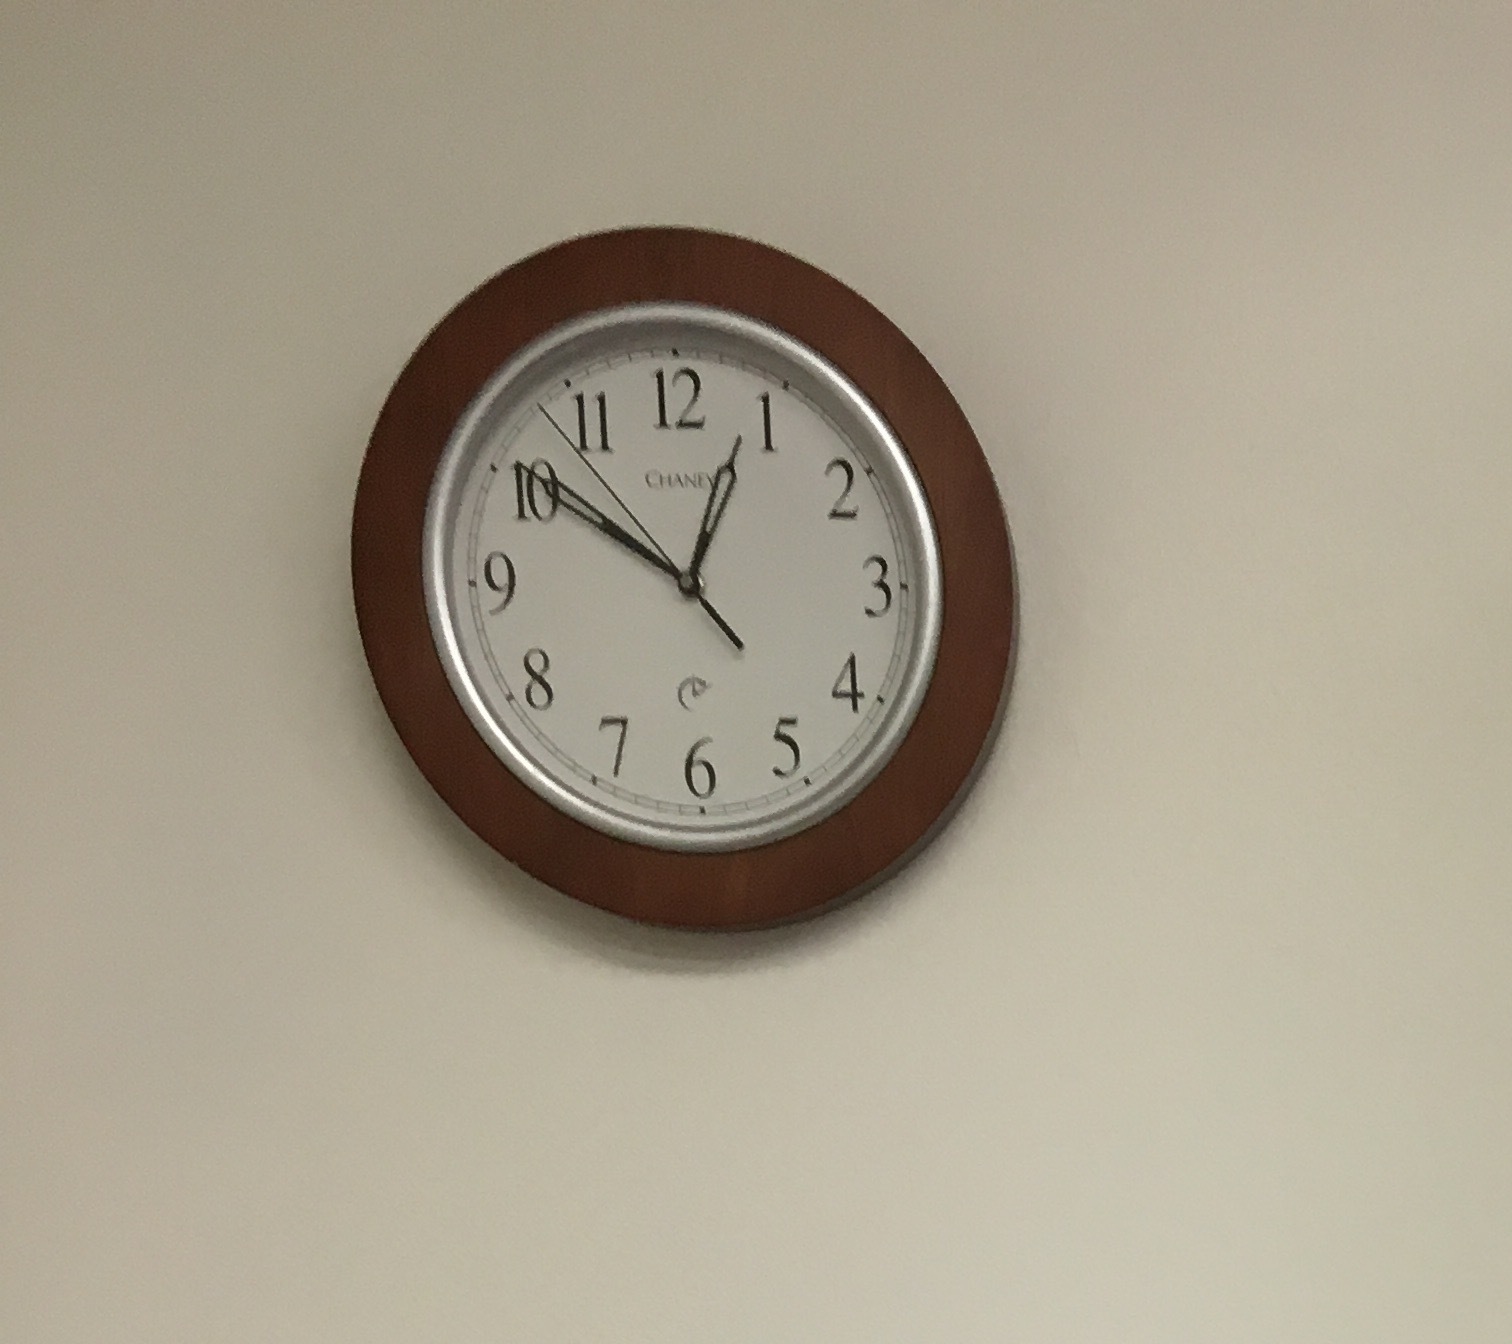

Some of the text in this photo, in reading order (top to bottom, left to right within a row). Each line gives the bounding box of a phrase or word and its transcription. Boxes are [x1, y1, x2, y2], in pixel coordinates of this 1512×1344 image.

[572, 392, 613, 453] 11
[650, 367, 706, 430] 12
[757, 393, 777, 453] 1
[513, 458, 560, 523] 10
[824, 459, 859, 519] 2
[484, 551, 516, 615] 9
[862, 554, 892, 618] 3
[523, 648, 554, 710] 8
[832, 652, 865, 714] 4
[598, 716, 628, 777] 7
[684, 737, 716, 798] 6
[772, 717, 801, 777] 5
